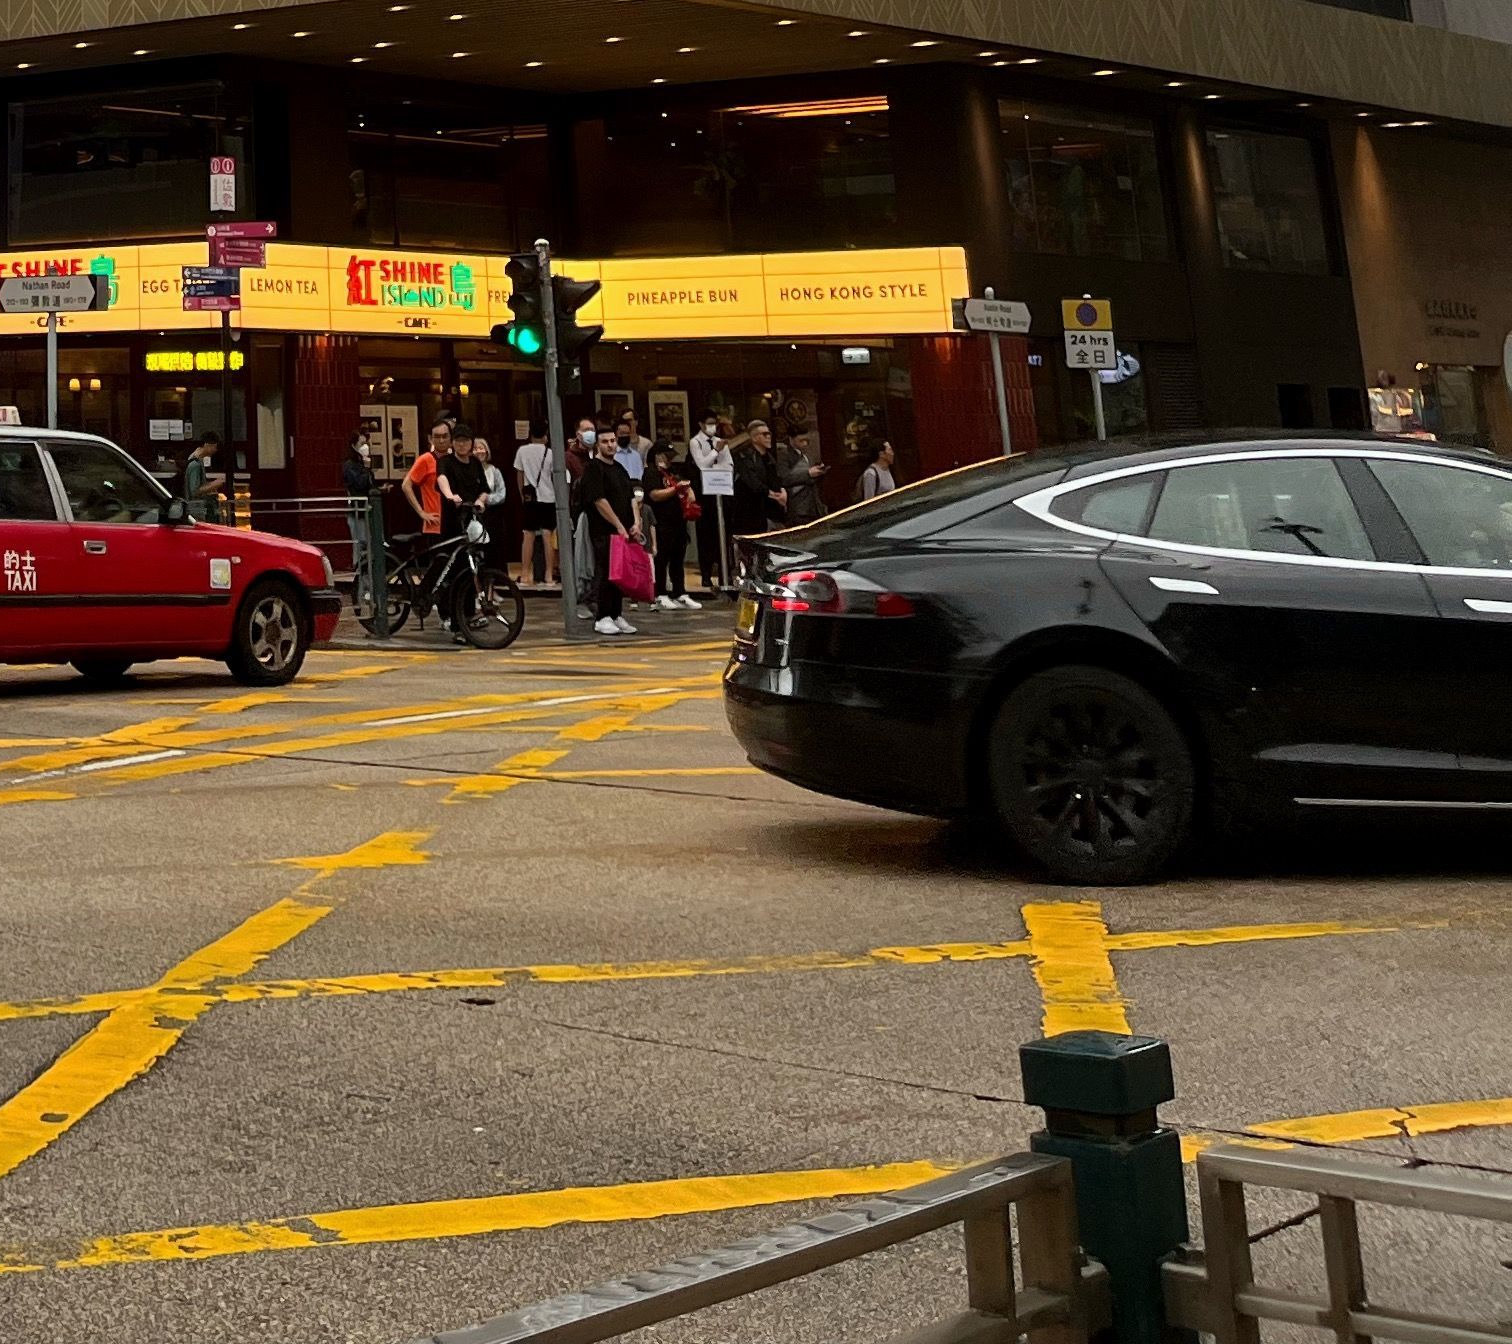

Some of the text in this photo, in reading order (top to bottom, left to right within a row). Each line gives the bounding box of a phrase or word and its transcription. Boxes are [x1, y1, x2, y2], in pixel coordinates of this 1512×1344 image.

[347, 255, 378, 305] 紅
[380, 260, 444, 284] SHINE
[22, 280, 70, 290] Nathan Road
[142, 279, 169, 293] EGG
[250, 278, 318, 295] LEMON TEA
[780, 284, 927, 301] HONG KONG STYLE
[488, 290, 511, 303] FRE
[627, 289, 738, 305] PINEAPPLE BUN
[37, 316, 67, 327] CFE
[1071, 334, 1109, 346] 24 hrs
[1076, 349, 1105, 364] 全日
[3, 550, 36, 571] 的士
[4, 570, 37, 591] TAXI
